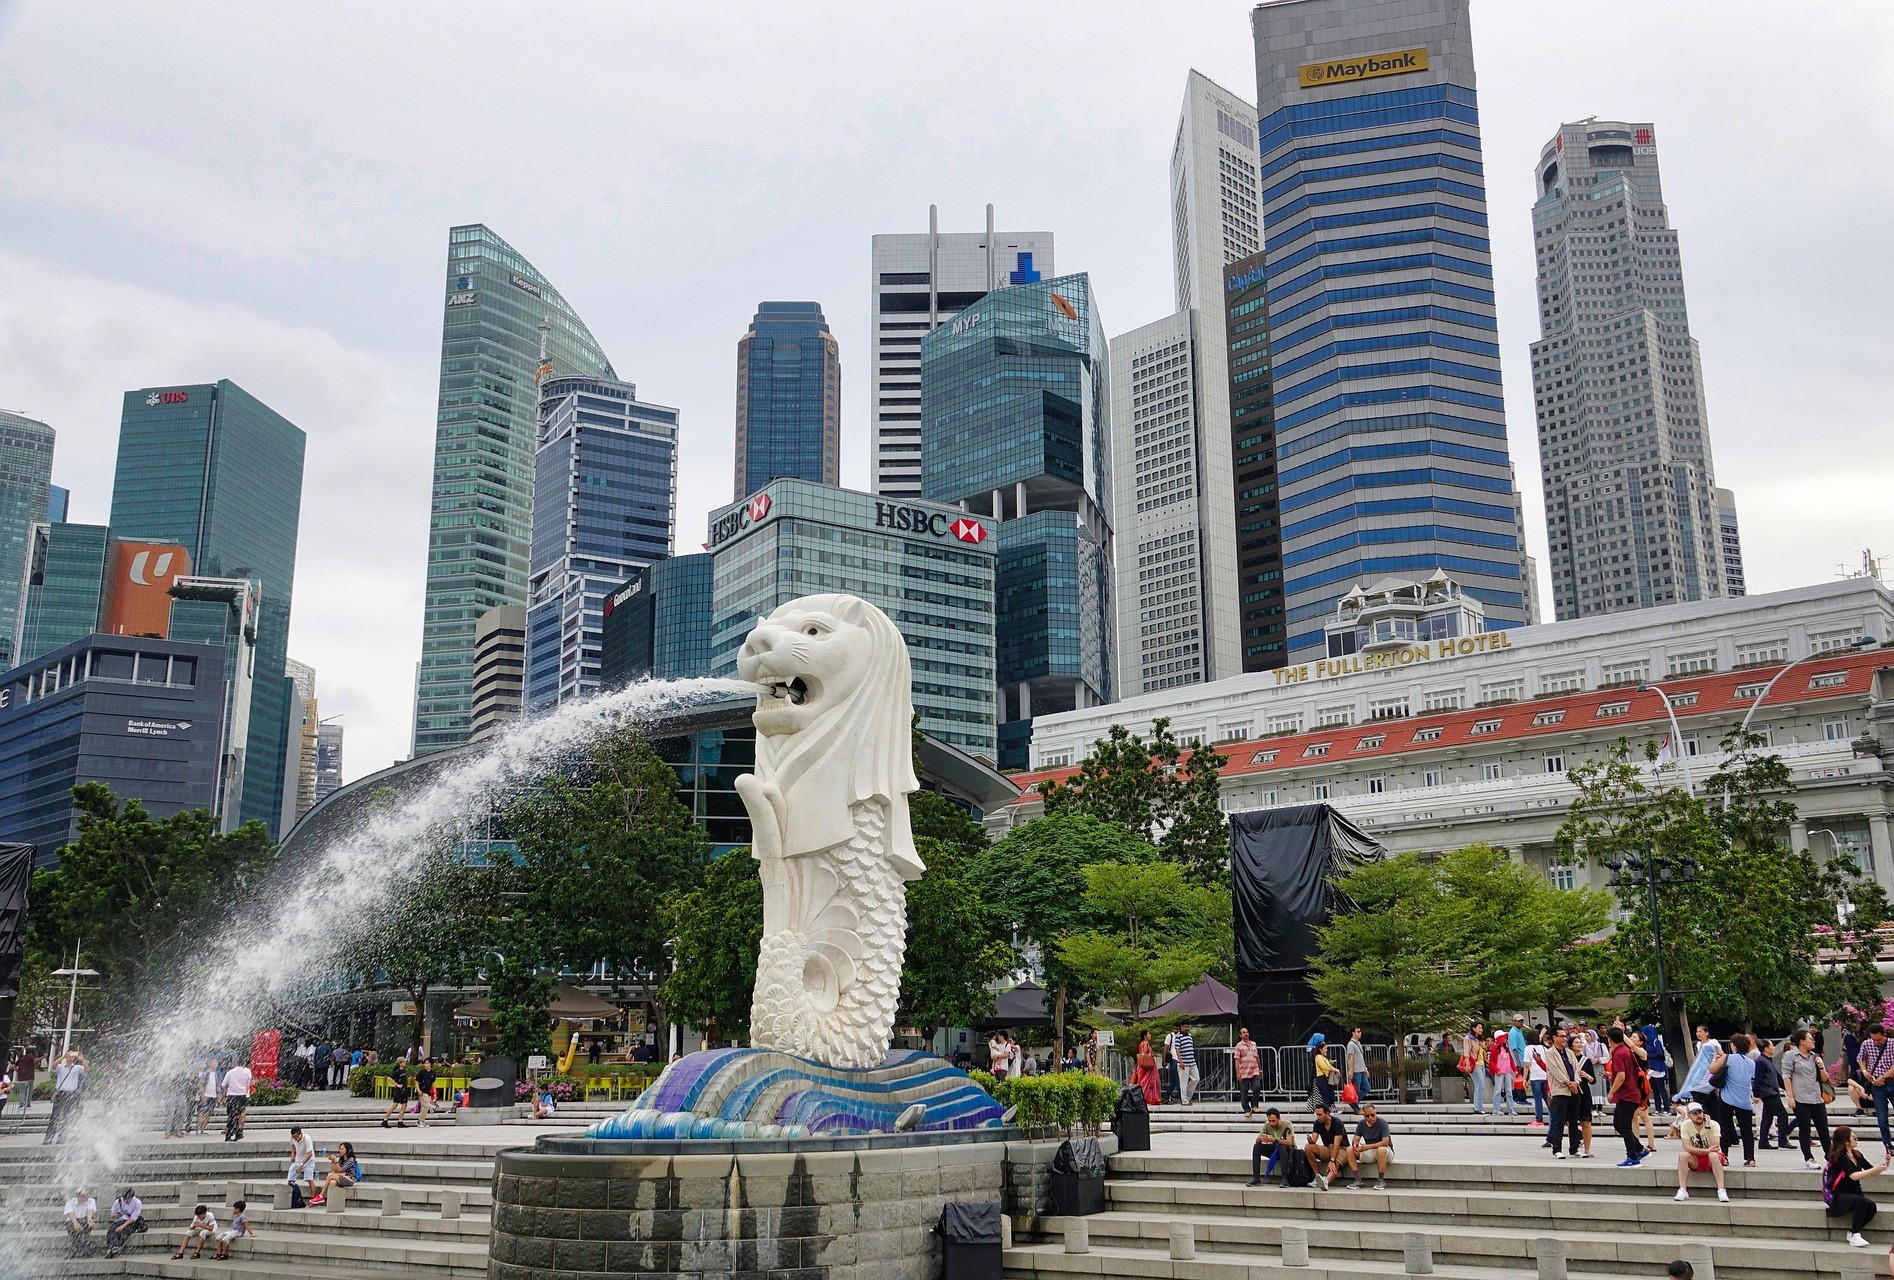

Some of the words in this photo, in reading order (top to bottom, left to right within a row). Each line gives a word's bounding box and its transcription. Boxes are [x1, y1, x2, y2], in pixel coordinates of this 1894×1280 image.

[1327, 53, 1416, 78] Maybank
[1633, 147, 1656, 155] UOB
[512, 275, 540, 295] Keppel
[448, 293, 476, 306] ANZ
[952, 314, 980, 336] MYP
[161, 391, 188, 404] UBS
[711, 504, 750, 547] HSBC
[875, 502, 948, 537] HSBC
[1272, 665, 1308, 685] THE
[1315, 644, 1429, 678] FULLERTON
[1439, 631, 1511, 657] HOTEL
[127, 726, 149, 734] Merrill
[149, 728, 168, 736] Lynch
[151, 722, 176, 730] America
